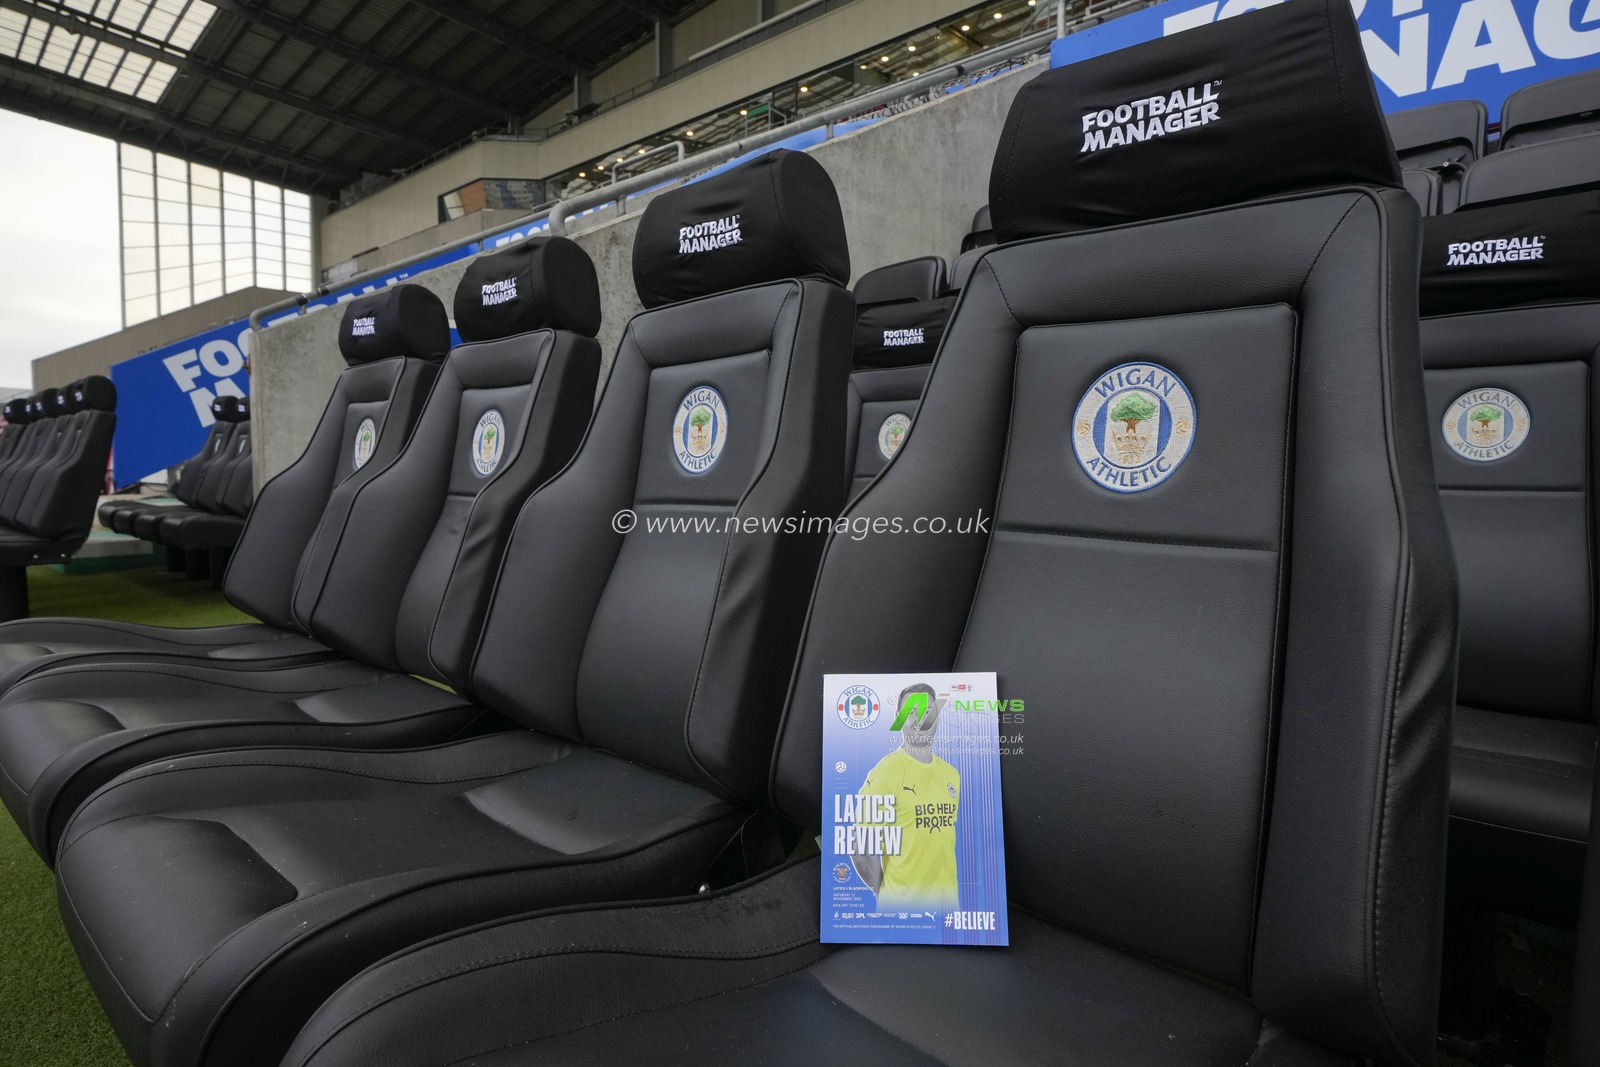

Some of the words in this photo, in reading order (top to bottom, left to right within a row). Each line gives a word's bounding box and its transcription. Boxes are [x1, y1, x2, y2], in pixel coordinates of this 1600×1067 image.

[1082, 83, 1219, 132] FOOTBALL
[1080, 102, 1221, 152] MANAGER
[679, 215, 740, 240] FOOTBALL
[679, 229, 743, 254] MANAGER
[1448, 236, 1545, 254] FOOTBALL
[1446, 248, 1544, 266] MANAGER
[482, 278, 516, 295] FOOTBALL
[483, 288, 518, 306] MANAGER
[883, 328, 924, 338] FOOTBALL
[883, 336, 925, 346] MANAGER
[1094, 368, 1177, 398] WIGAN
[683, 391, 720, 411] WIGAN
[1456, 391, 1515, 410] WIGAN
[480, 413, 501, 427] WIGAN
[1453, 440, 1515, 458] ATHLETIC
[476, 458, 497, 472] ATHLETIC
[679, 448, 718, 470] ATHLETIC
[1086, 456, 1172, 487] ATHLETIC
[844, 687, 873, 698] WIGAN
[843, 717, 873, 729] ATHLETIC
[834, 794, 896, 823] LATICS
[915, 804, 935, 816] BIG
[834, 826, 903, 856] REVIEW
[944, 911, 996, 931] #BELIEVE
